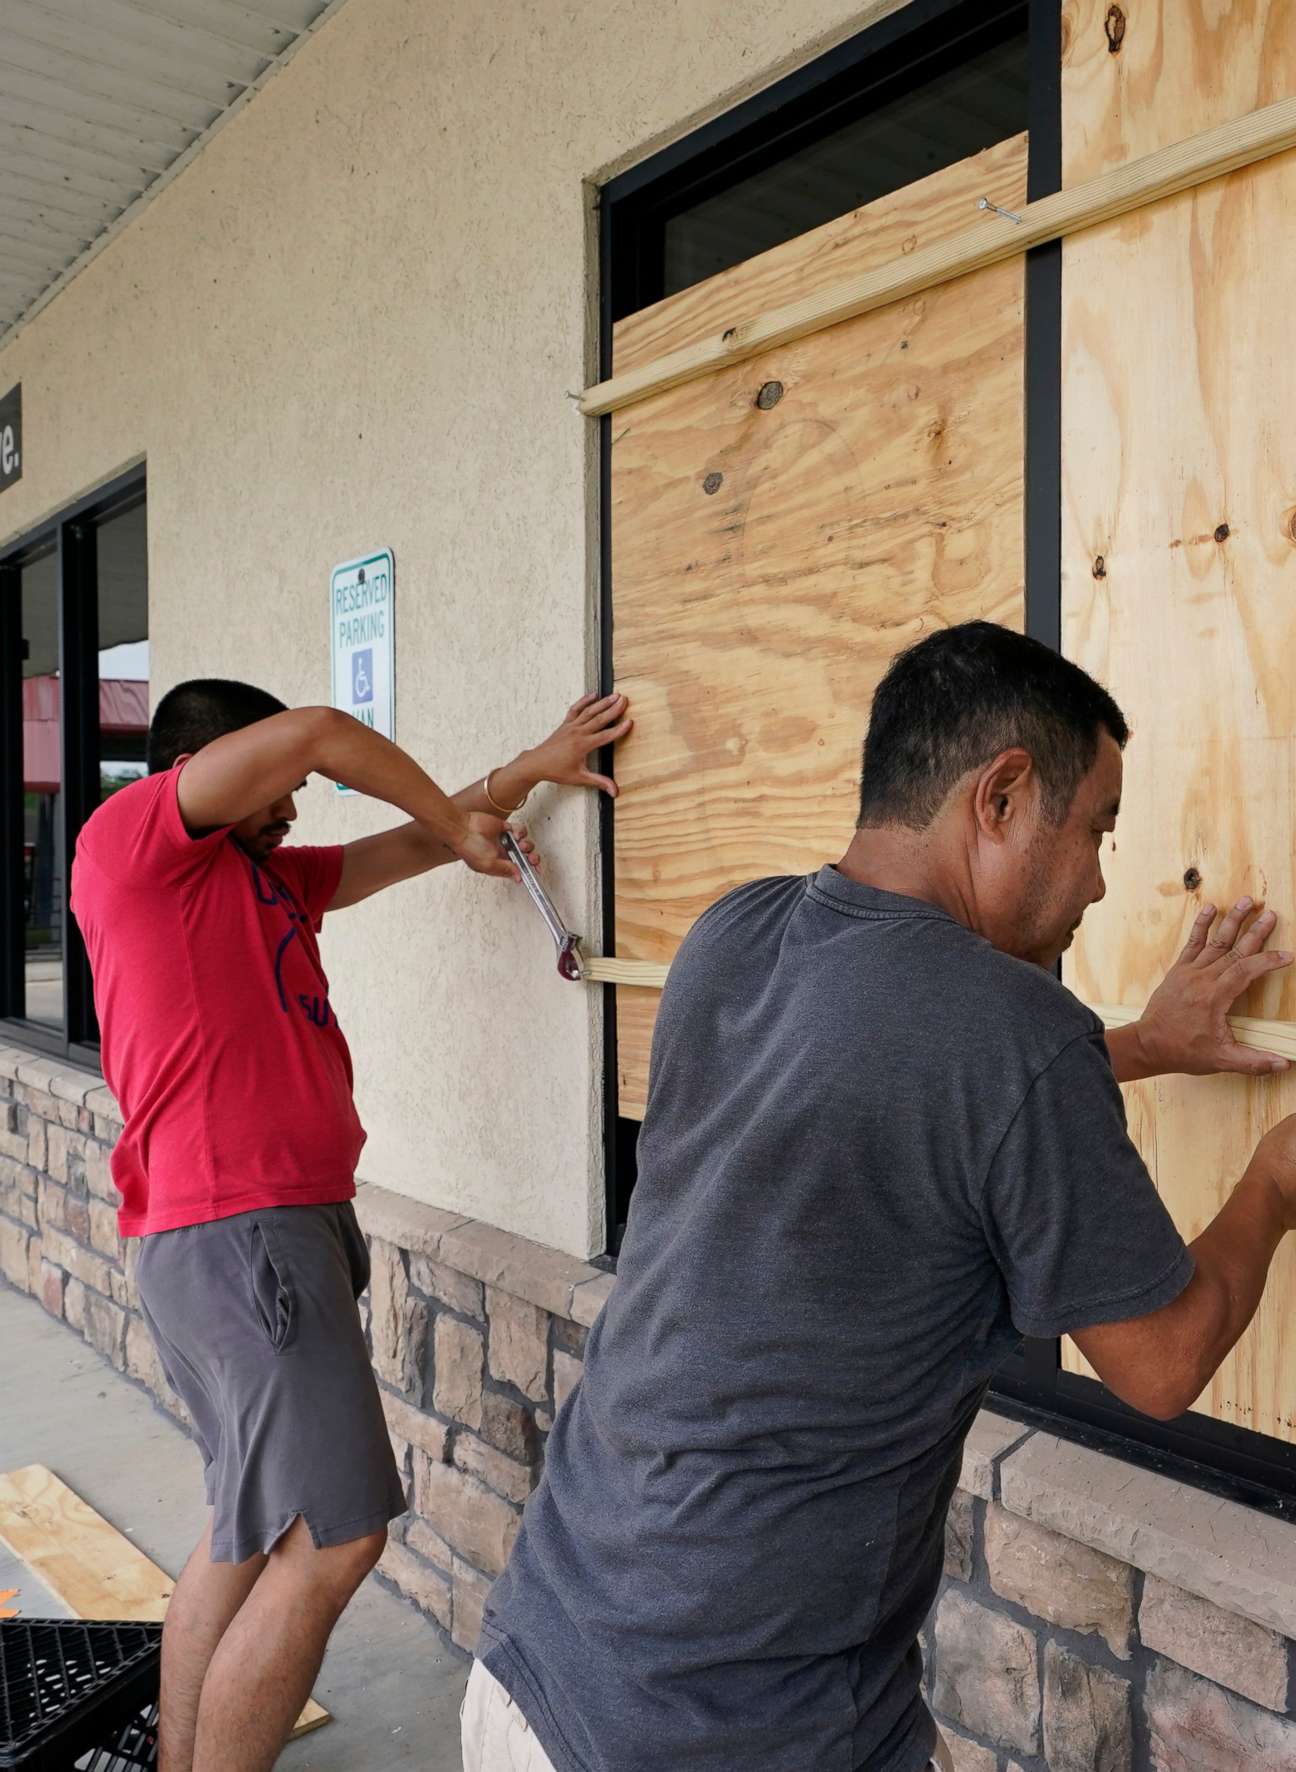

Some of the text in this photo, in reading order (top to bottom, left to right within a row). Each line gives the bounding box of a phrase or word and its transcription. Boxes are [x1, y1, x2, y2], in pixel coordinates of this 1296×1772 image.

[0, 425, 19, 475] e.
[336, 573, 388, 616] RESERVED
[339, 610, 385, 648] PARKING
